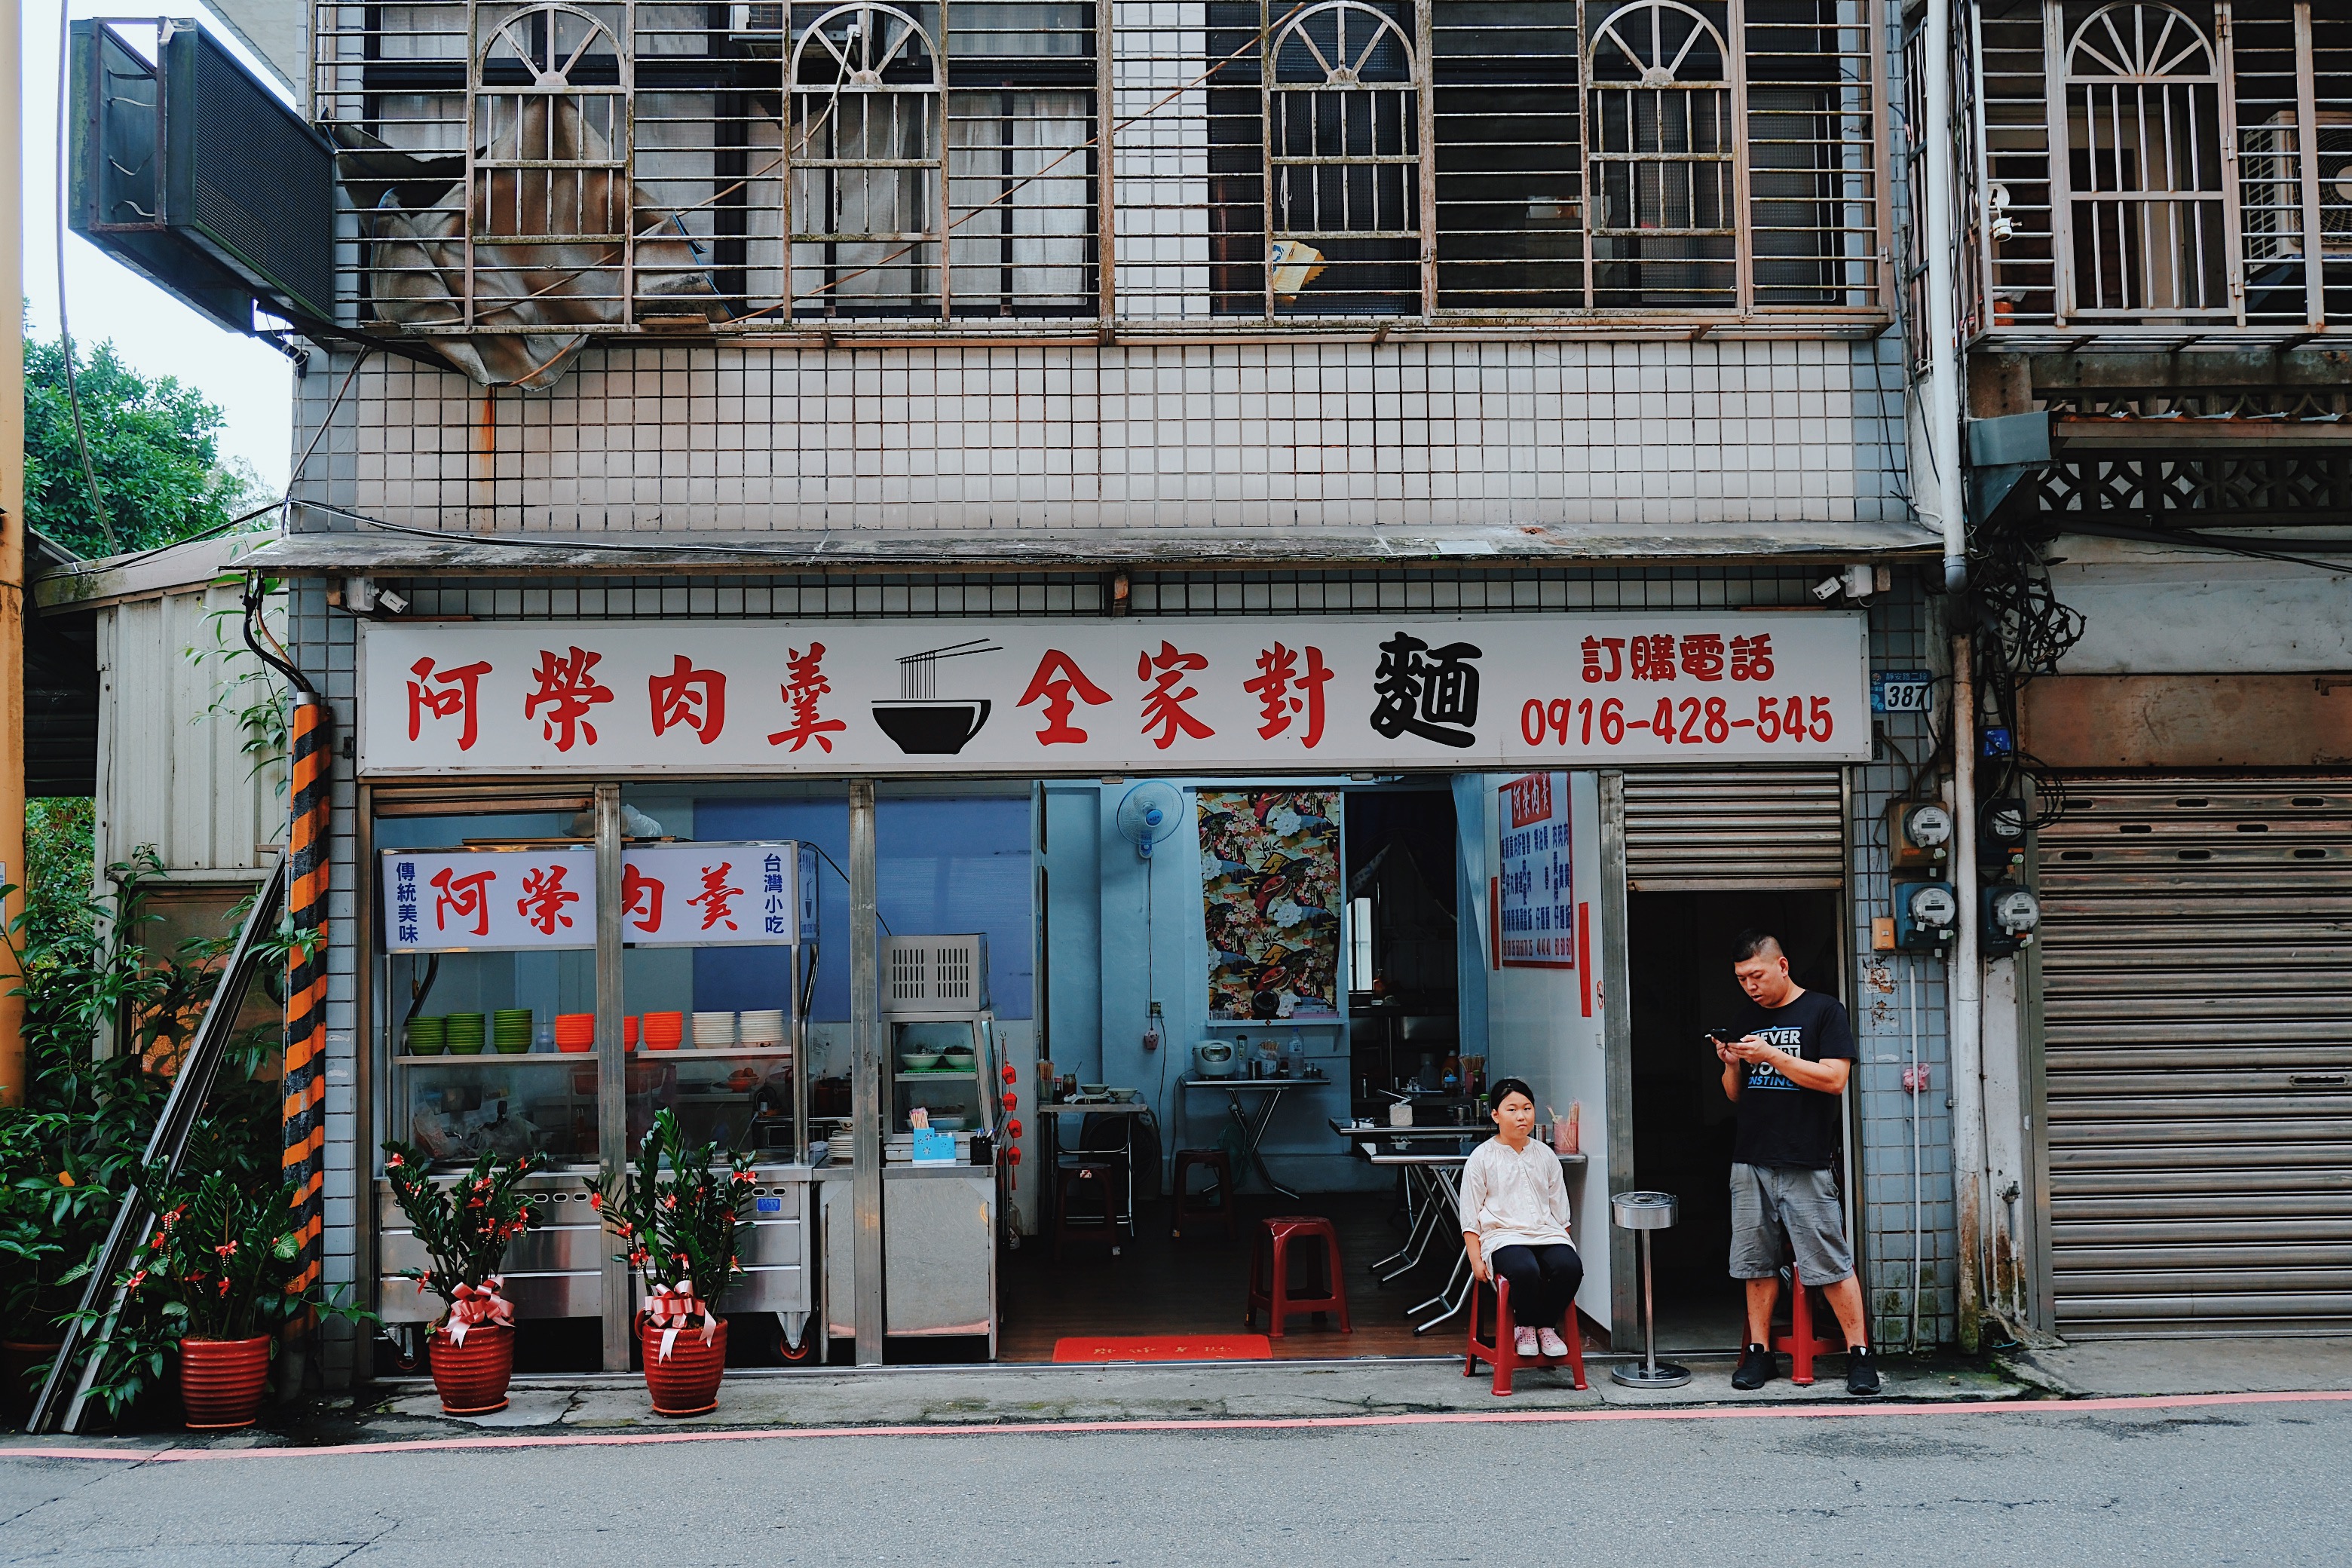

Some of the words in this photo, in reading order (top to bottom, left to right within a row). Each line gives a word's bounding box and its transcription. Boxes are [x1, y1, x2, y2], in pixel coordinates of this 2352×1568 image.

[1582, 634, 1775, 683] 訂購電話
[1885, 672, 1928, 681] 靜安路二段
[407, 643, 847, 754] 阿榮肉羹
[1017, 632, 1483, 750] 全家對麵
[1888, 685, 1926, 707] 387
[1521, 696, 1833, 746] 0916-428-545
[1512, 773, 1549, 821] 阿榮肉羹
[397, 862, 418, 944] 傳統美味
[430, 862, 744, 936] 阿榮肉羹
[763, 854, 785, 935] 台灣小吃
[1756, 1030, 1801, 1045] EVER
[1748, 1076, 1799, 1087] INSTINC
